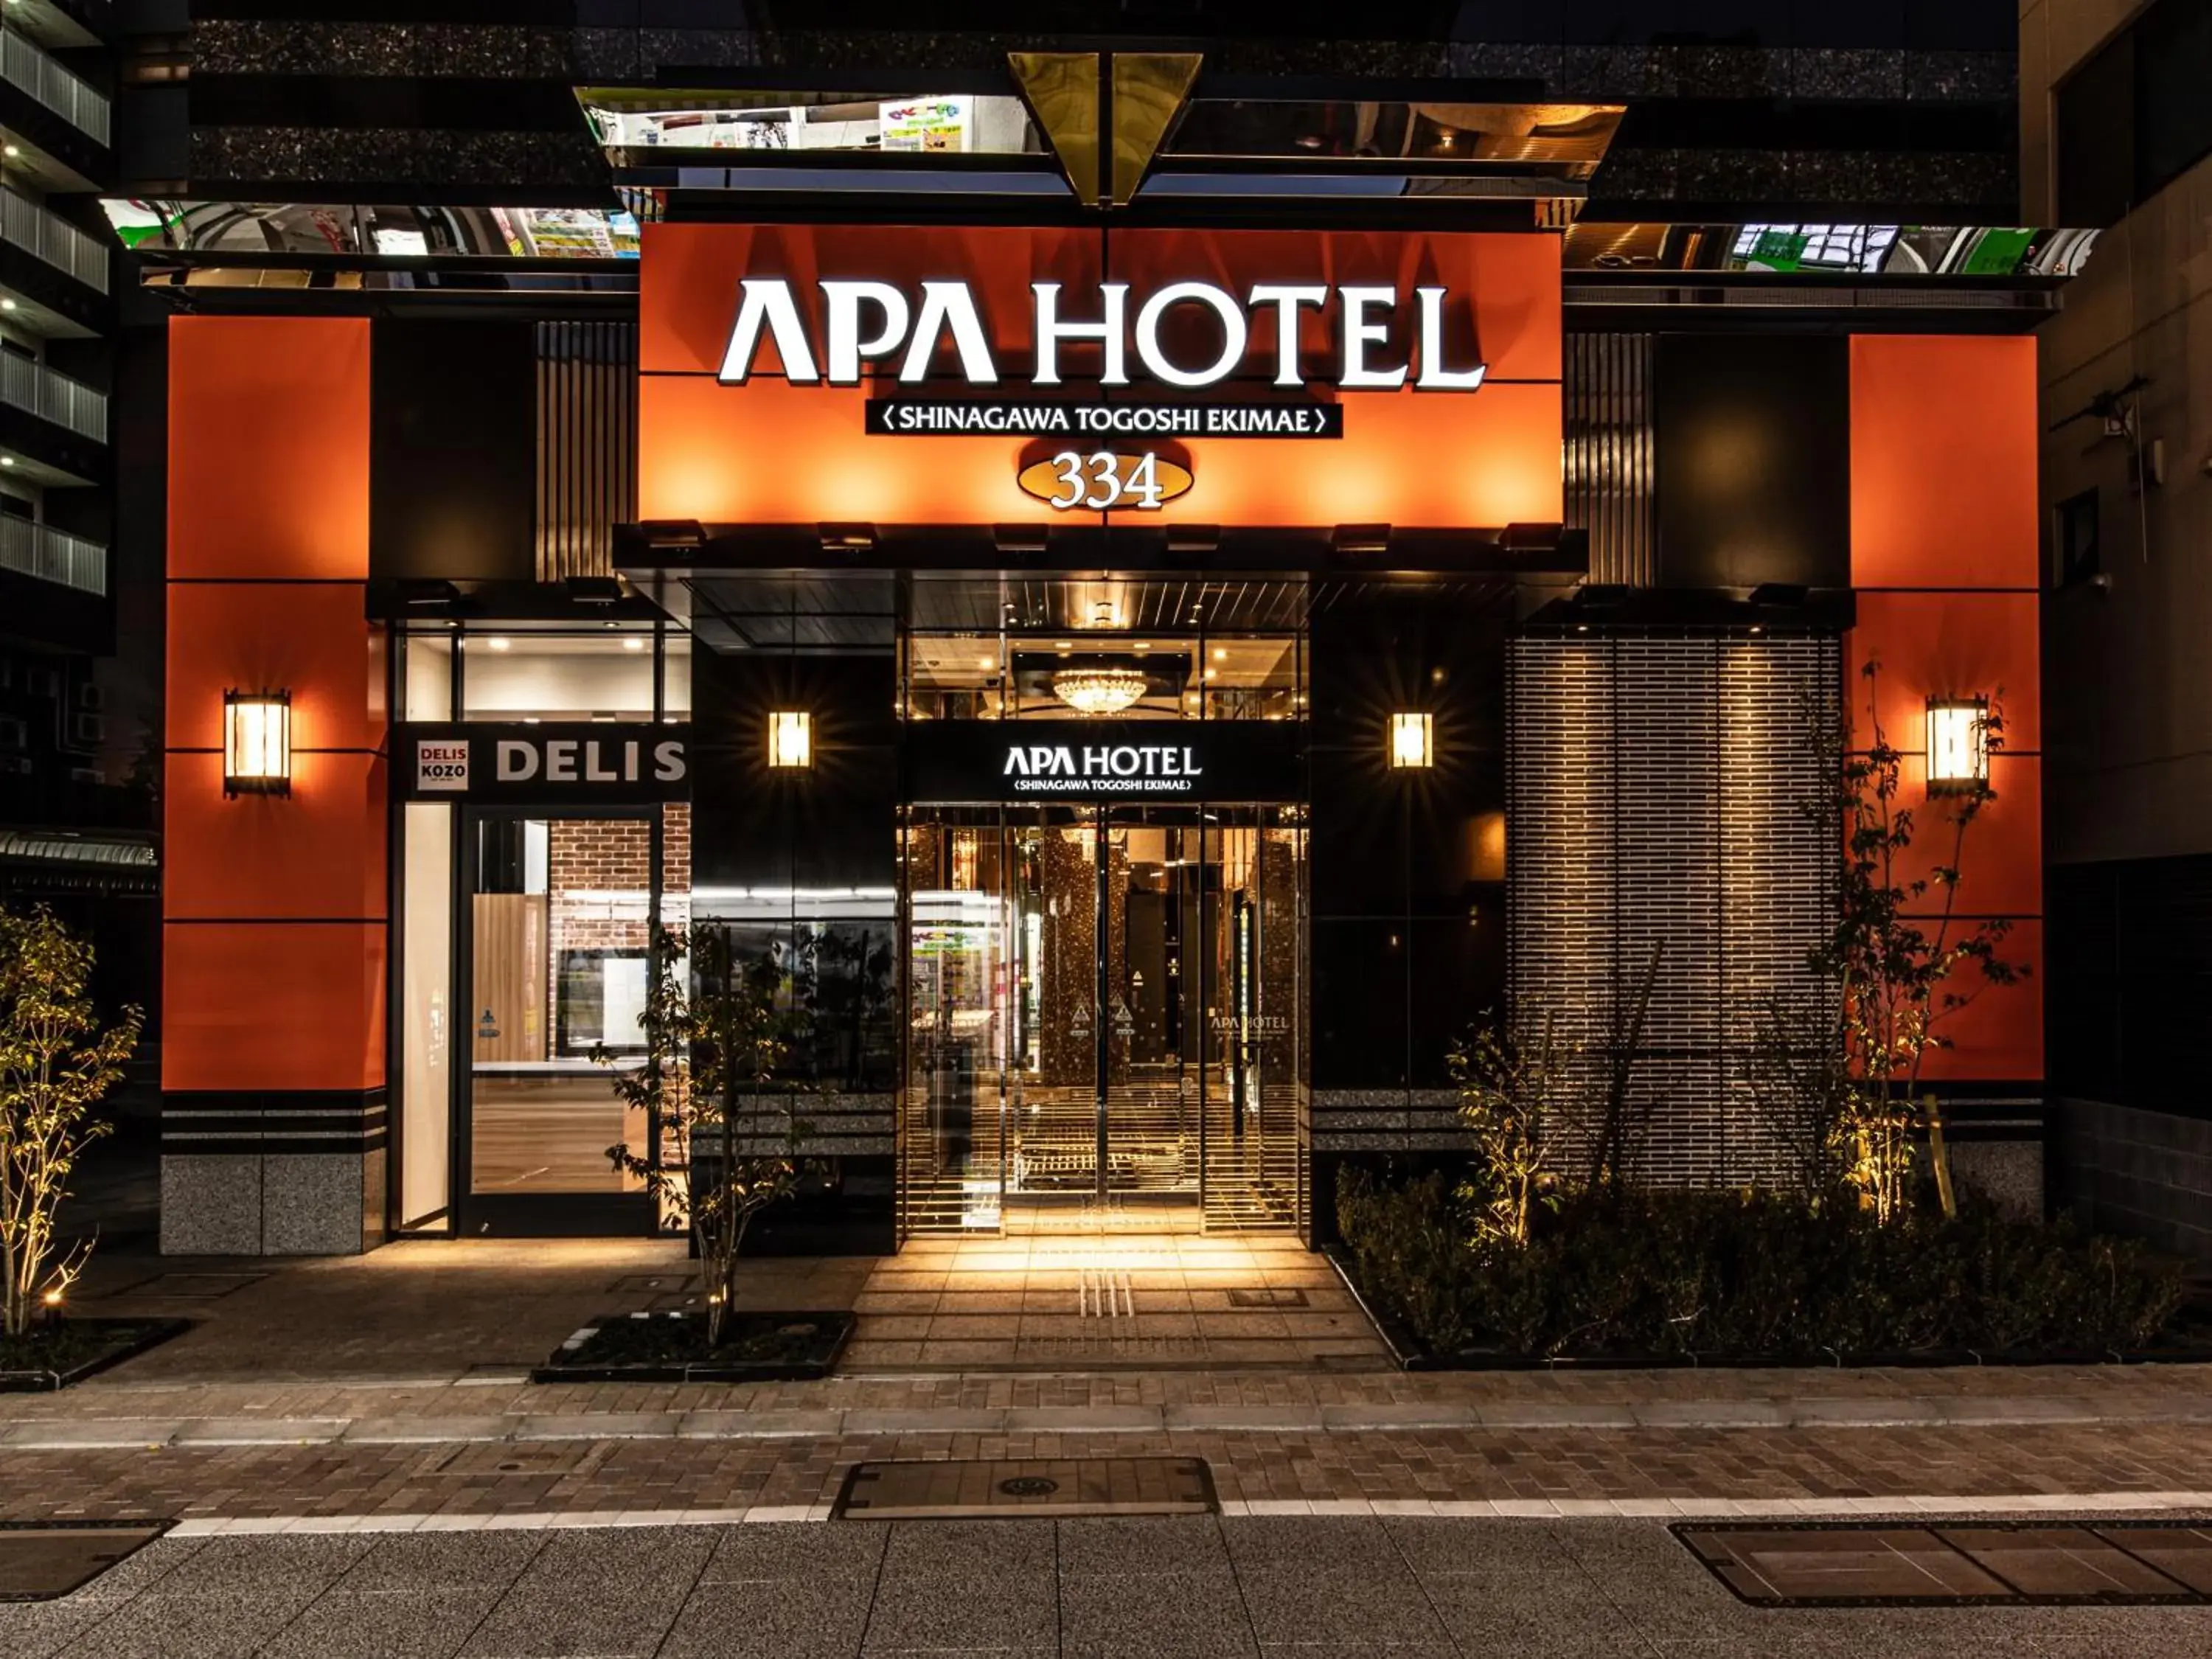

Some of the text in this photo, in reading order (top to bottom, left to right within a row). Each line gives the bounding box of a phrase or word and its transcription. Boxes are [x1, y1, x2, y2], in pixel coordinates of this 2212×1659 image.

[719, 280, 1486, 388] APA HOTEL
[1075, 408, 1199, 431] TOGOSHI
[1050, 451, 1163, 509] 334
[421, 748, 466, 759] DELIS
[497, 740, 686, 781] DELIS
[1003, 745, 1203, 776] APA HOTEL
[422, 765, 465, 776] KOZO
[1091, 779, 1143, 791] TOGOSHI
[1211, 1017, 1239, 1029] APA
